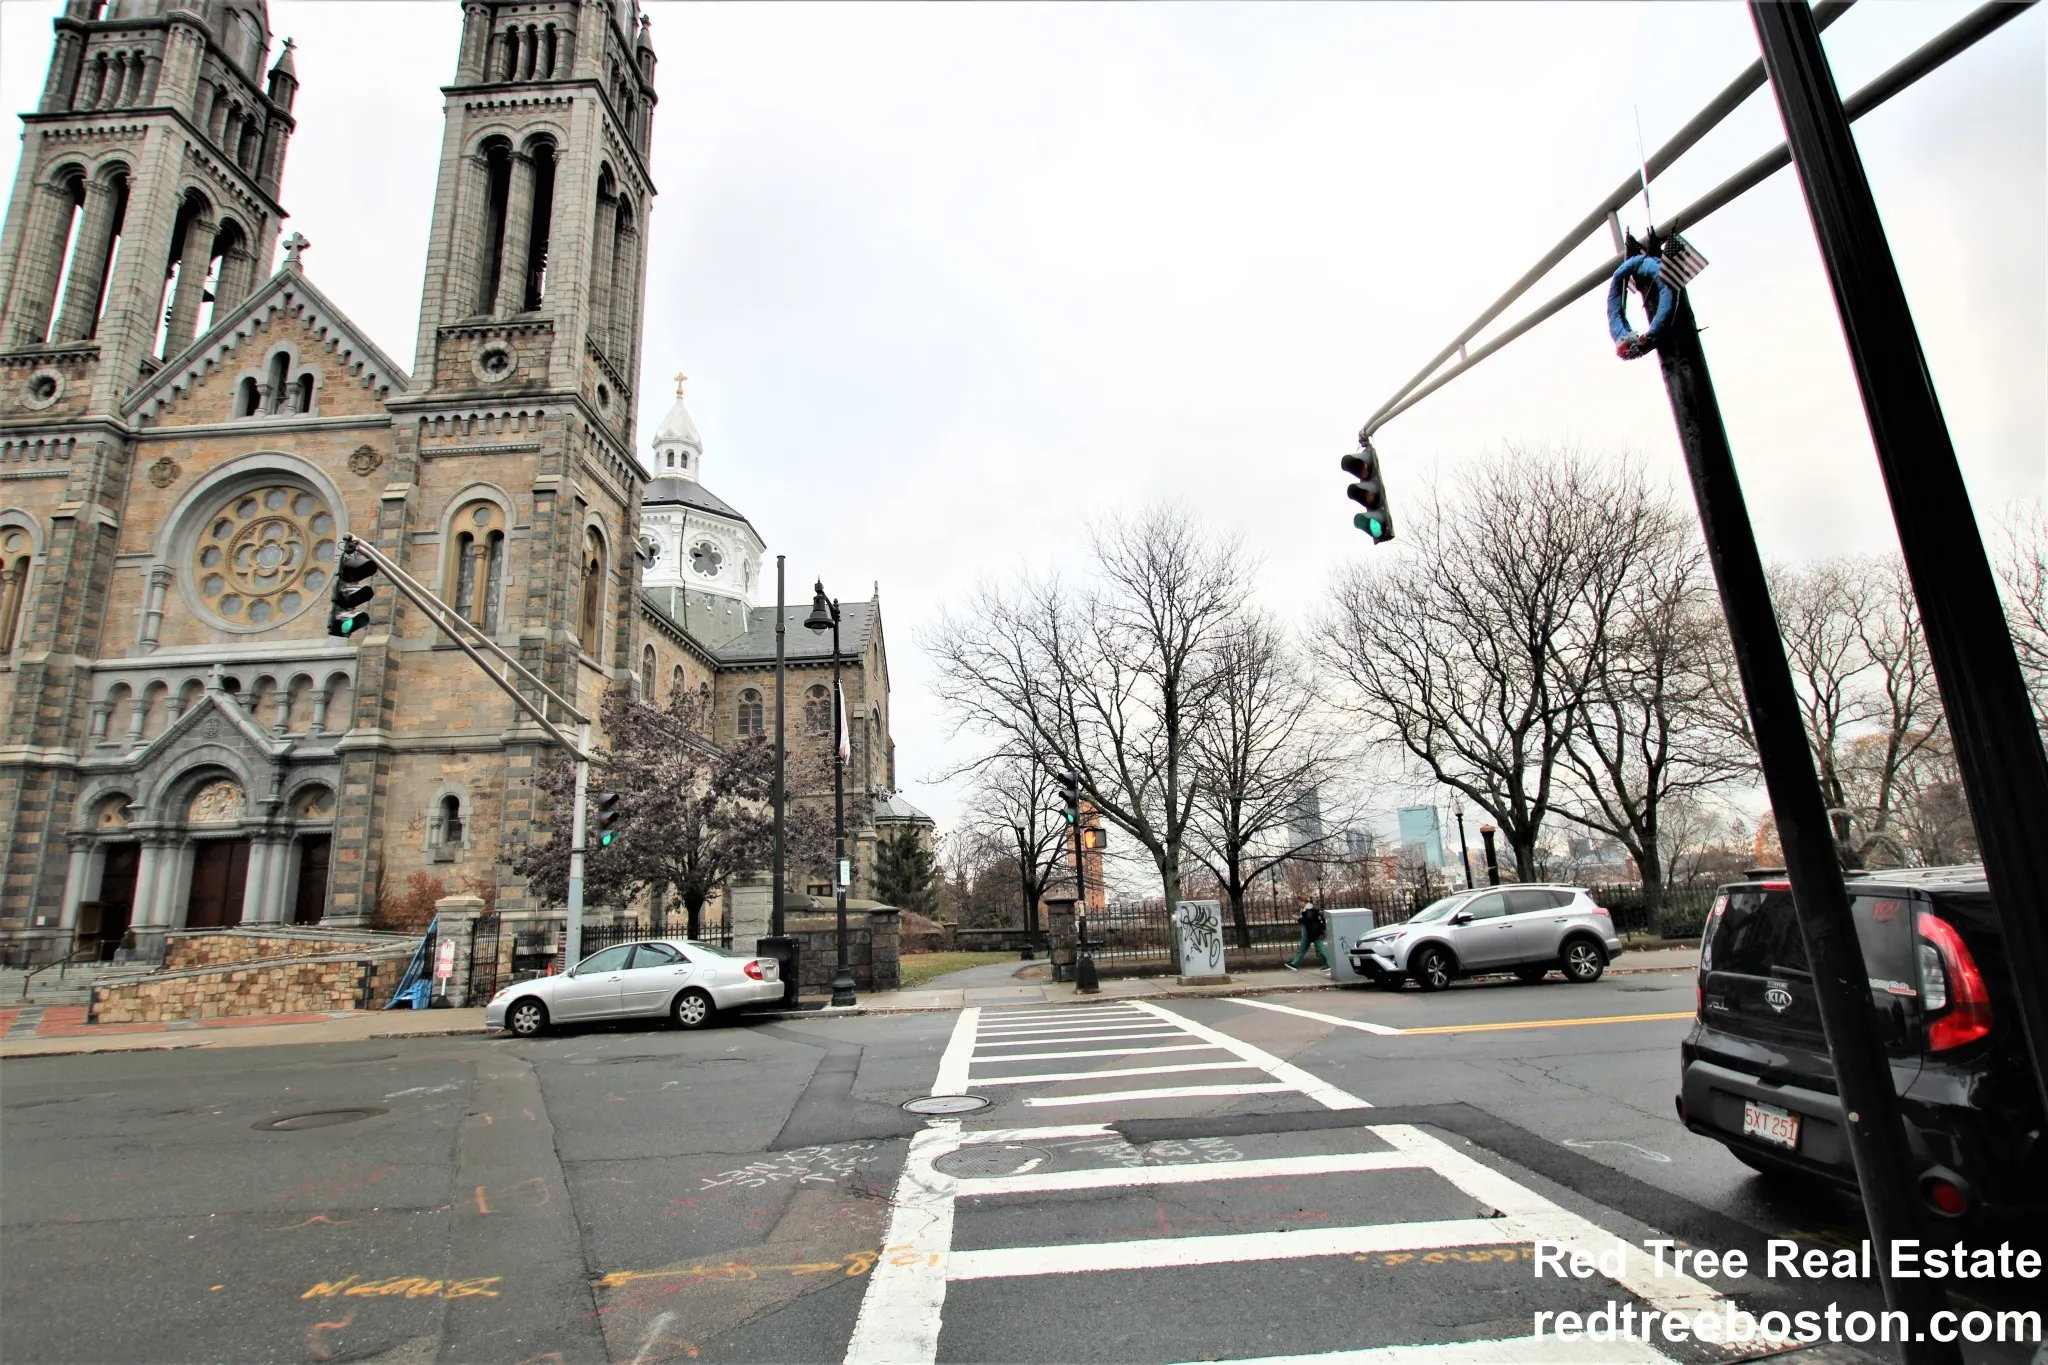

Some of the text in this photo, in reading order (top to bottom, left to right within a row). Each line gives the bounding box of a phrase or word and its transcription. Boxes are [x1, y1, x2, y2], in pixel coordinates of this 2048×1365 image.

[1768, 992, 1787, 1004] KIA
[1745, 1108, 1770, 1131] 5XT
[1771, 1117, 1795, 1141] 251
